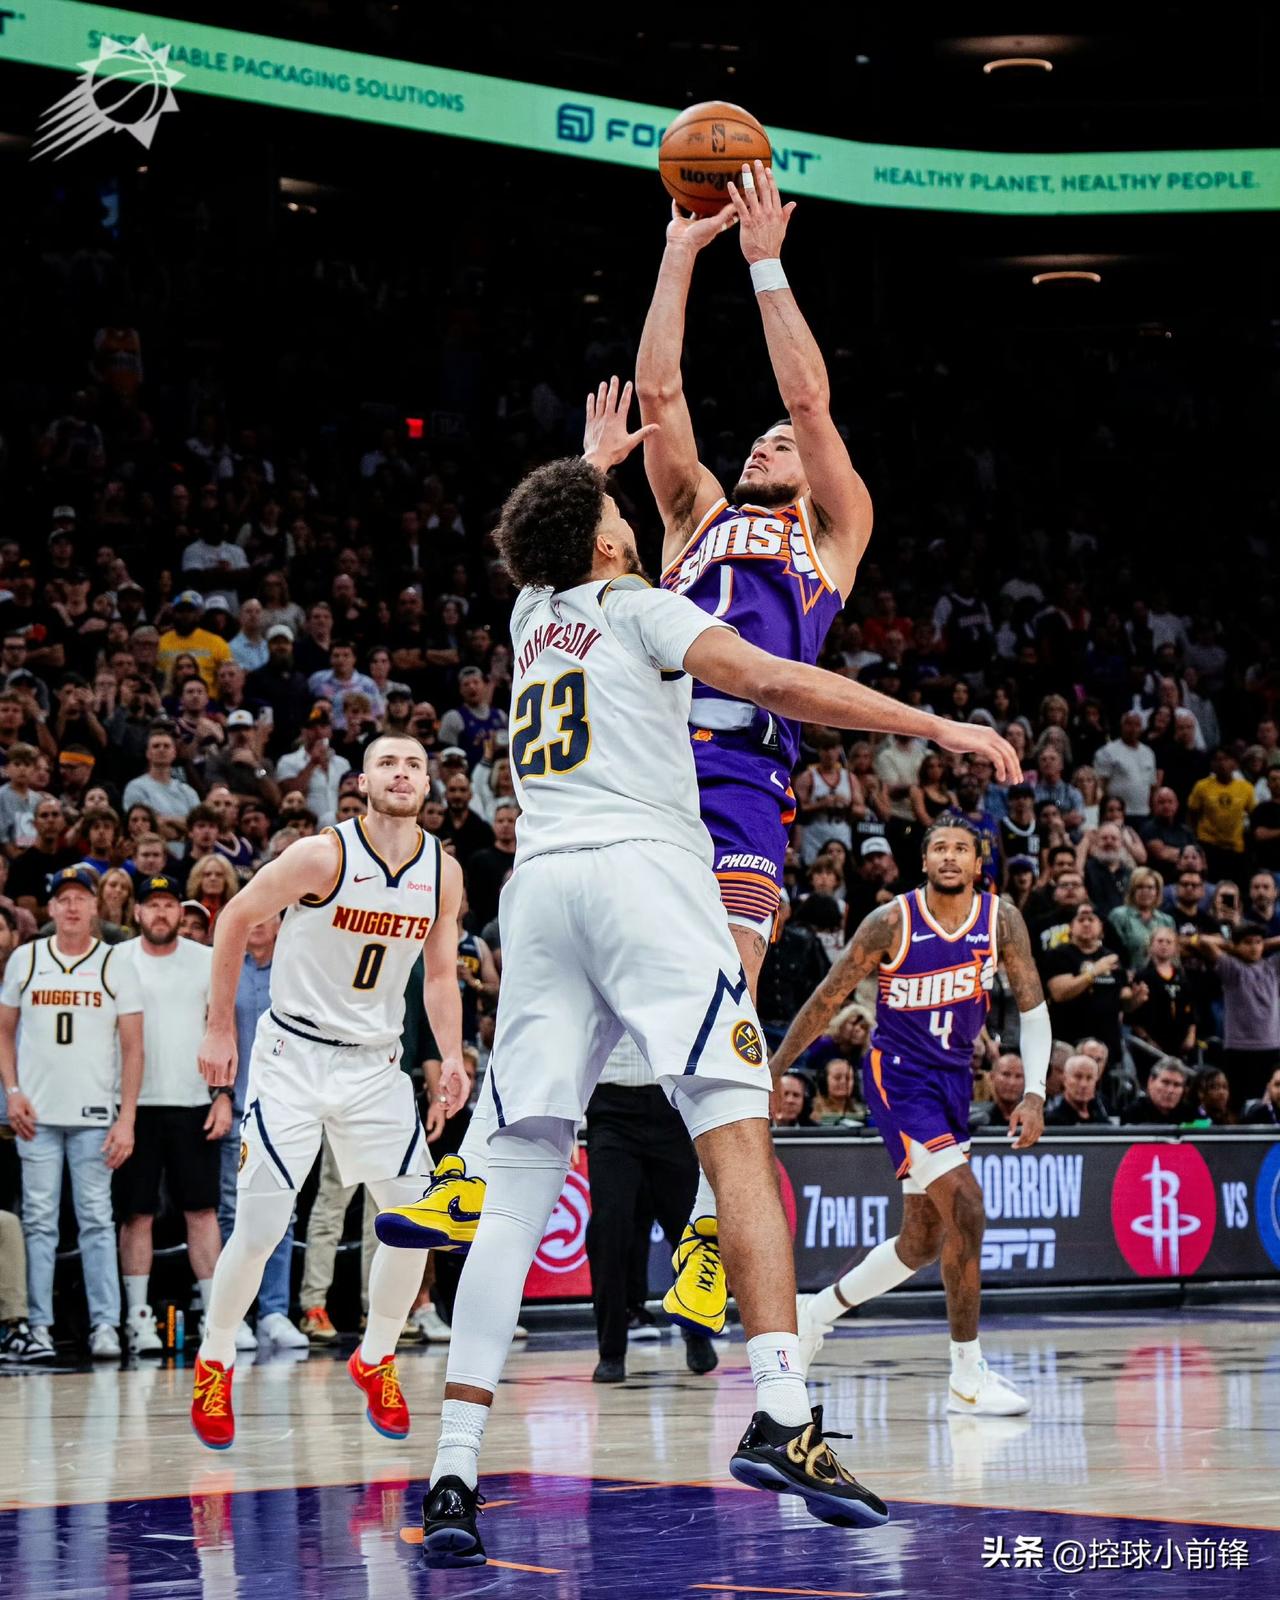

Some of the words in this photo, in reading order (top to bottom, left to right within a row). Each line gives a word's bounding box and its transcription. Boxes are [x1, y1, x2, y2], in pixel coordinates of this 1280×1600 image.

[233, 55, 351, 92] PACKAGING
[355, 77, 465, 112] SOLUTIONS
[873, 166, 964, 190] HEALTHY
[969, 172, 1055, 194] PLANET,
[1061, 172, 1162, 193] HEALTHY
[518, 622, 602, 679] JOHNSON
[512, 668, 592, 782] 23
[407, 880, 432, 892] ibotta
[716, 853, 778, 878] PHOENIX
[332, 905, 431, 940] NUGGETS
[352, 942, 387, 992] 0
[887, 965, 977, 1009] SUNS
[31, 990, 103, 1008] NUGGETS
[56, 1012, 73, 1045] 0
[929, 1011, 954, 1050] 4
[971, 1153, 1084, 1220] ORROW
[1221, 1181, 1249, 1229] VS
[861, 1195, 889, 1248] ET
[979, 1228, 1057, 1271] SPN
